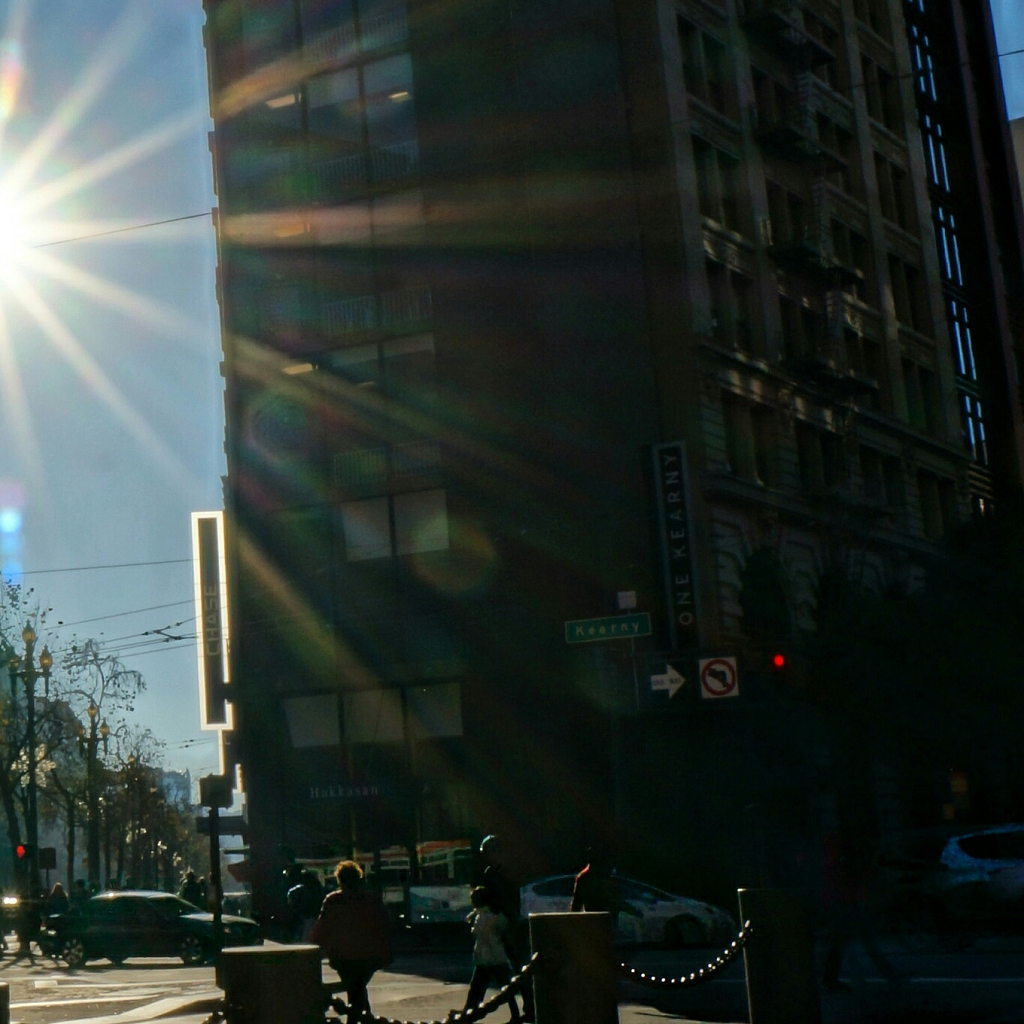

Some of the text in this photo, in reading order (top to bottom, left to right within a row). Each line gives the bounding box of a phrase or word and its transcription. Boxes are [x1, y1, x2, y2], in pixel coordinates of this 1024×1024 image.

[663, 454, 693, 626] ONE KEARNY
[204, 584, 220, 656] CHASE
[576, 620, 640, 637] Kearny
[309, 785, 378, 799] Hakkasan
